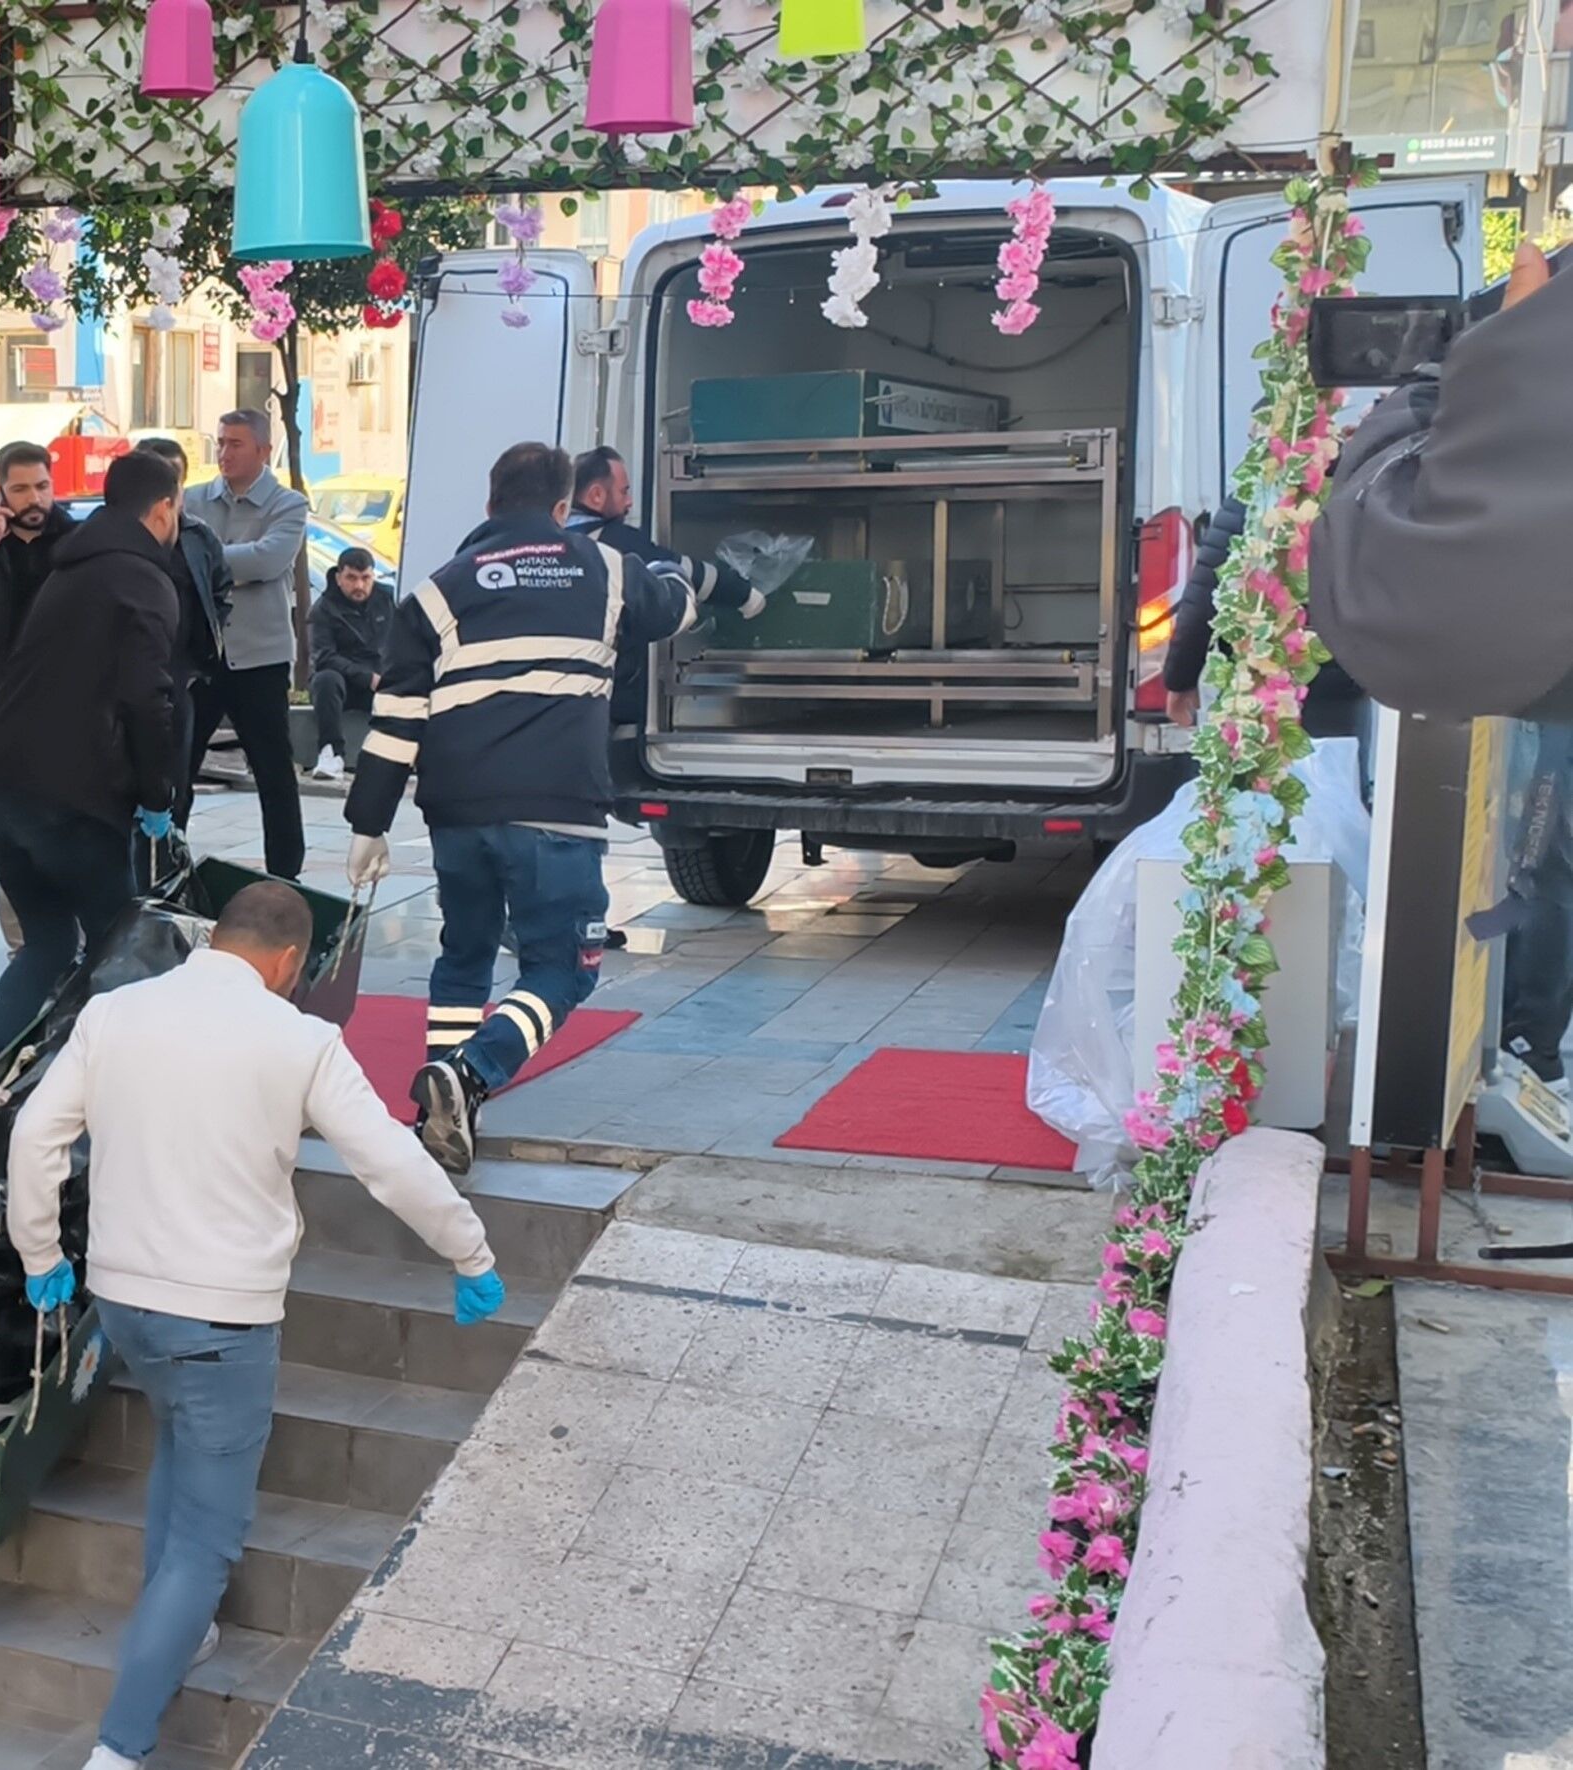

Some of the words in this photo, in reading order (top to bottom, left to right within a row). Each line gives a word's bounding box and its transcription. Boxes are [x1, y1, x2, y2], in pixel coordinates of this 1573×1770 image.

[515, 557, 559, 567] ANTALYA
[516, 566, 584, 578] BÜYÜKŞEHİR
[519, 577, 572, 588] BELEDİYESİ
